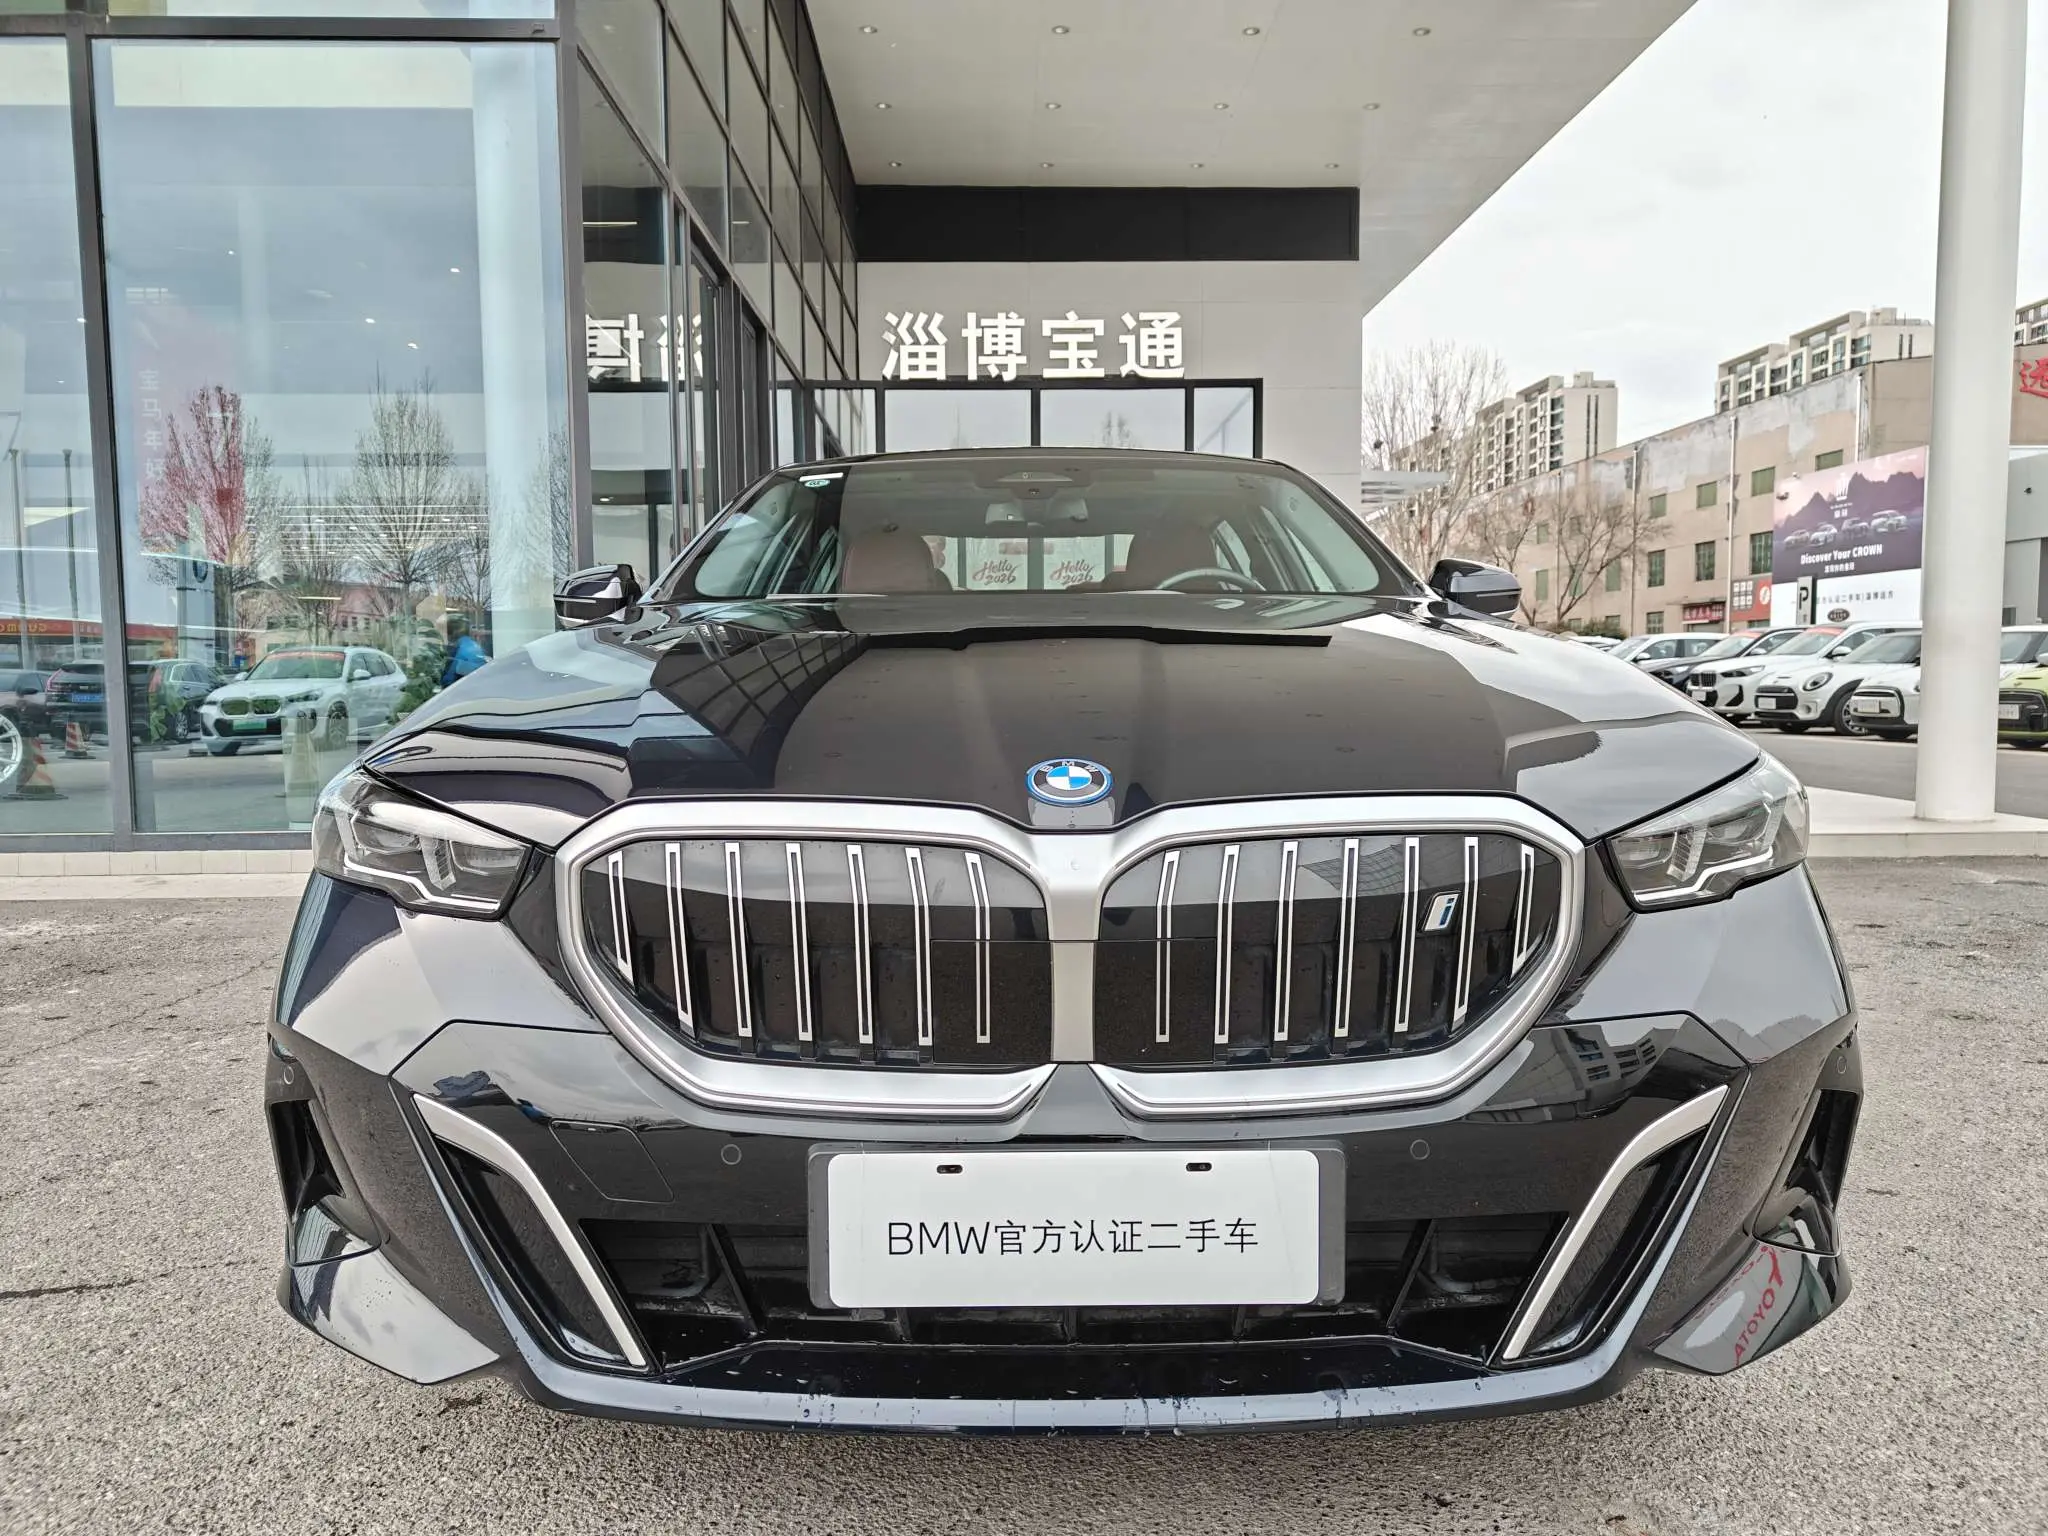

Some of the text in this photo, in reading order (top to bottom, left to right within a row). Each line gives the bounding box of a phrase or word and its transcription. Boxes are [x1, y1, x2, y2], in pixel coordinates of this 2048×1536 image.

[881, 310, 1185, 381] 淄博宝通
[1801, 544, 1883, 565] Discover Your CROWN
[972, 559, 1014, 581] Hello
[1050, 559, 1091, 581] Hello
[1799, 586, 1809, 611] P
[888, 1217, 1259, 1255] BMW官方认证二手车
